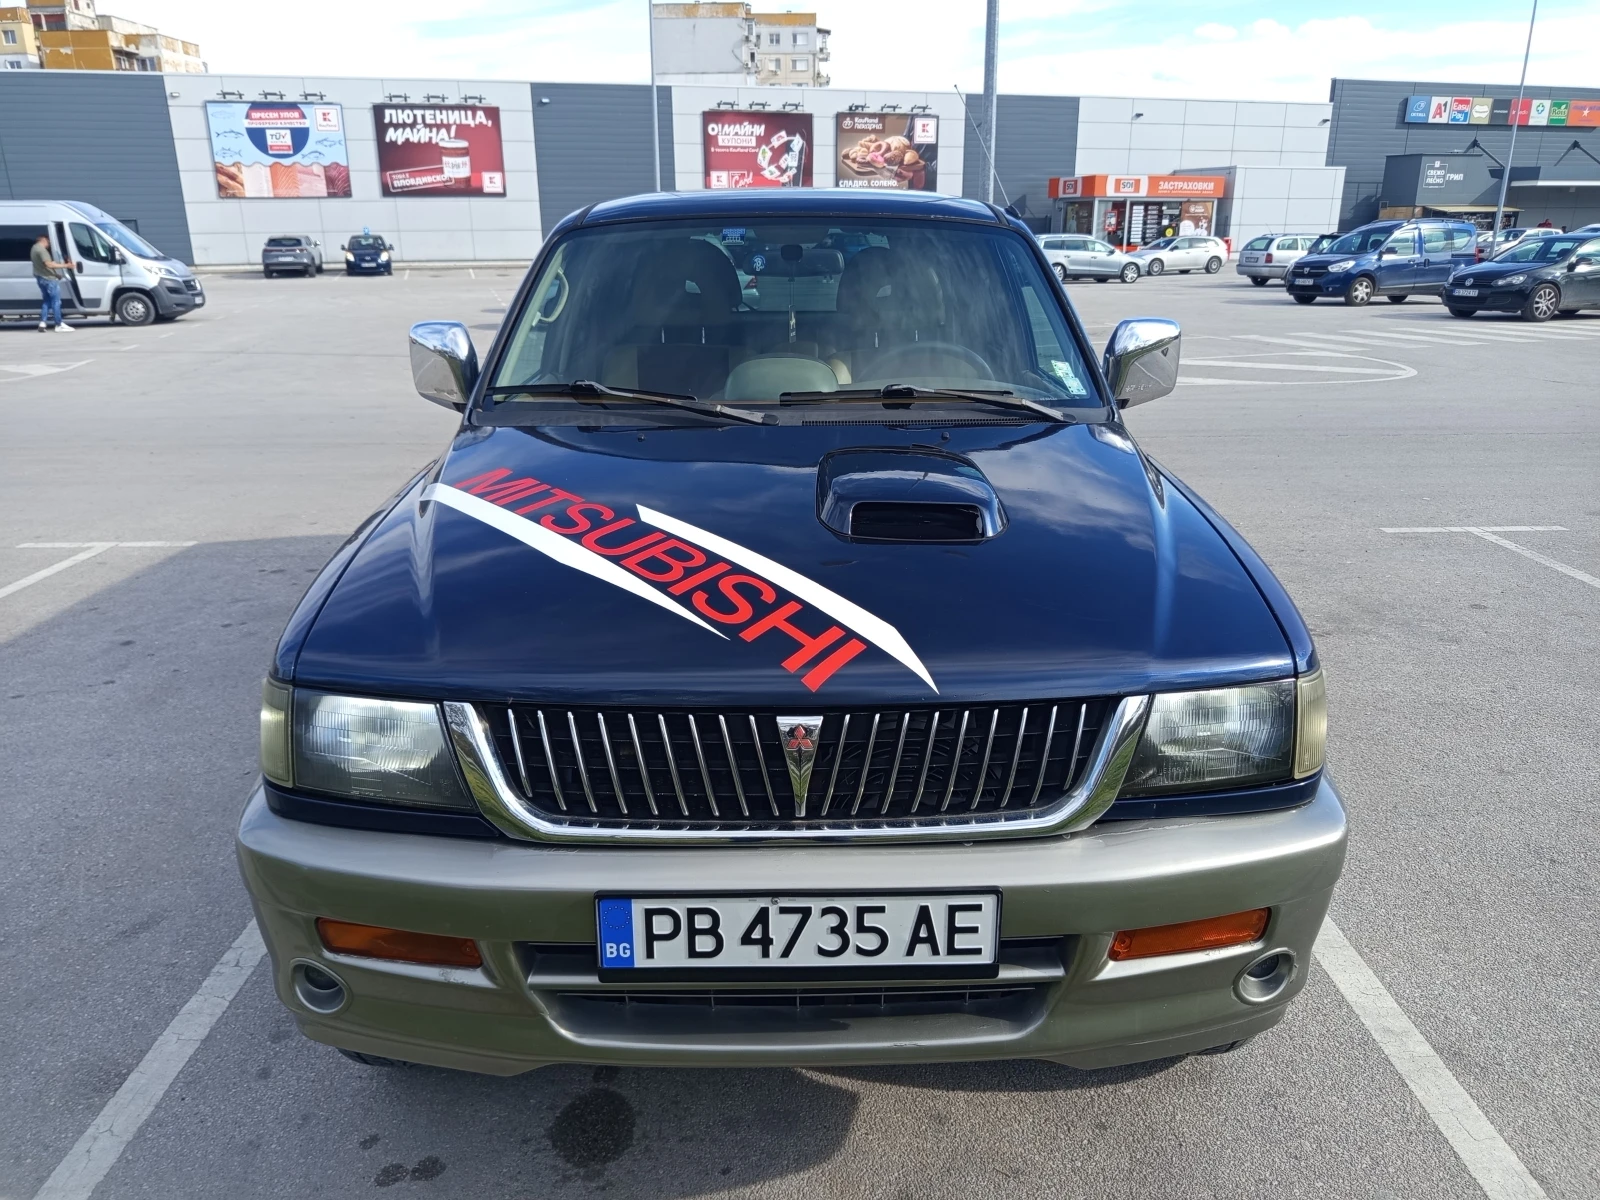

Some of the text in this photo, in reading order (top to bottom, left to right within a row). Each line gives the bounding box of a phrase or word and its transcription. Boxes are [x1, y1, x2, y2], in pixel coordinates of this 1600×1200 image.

[251, 111, 279, 119] ПРЕСЕН
[1432, 101, 1448, 119] A1
[1453, 102, 1470, 112] Easy
[383, 109, 492, 127] ЛЮТЕНИЦА,
[1451, 111, 1465, 121] Pay
[385, 124, 457, 145] МАЙНА!
[1446, 173, 1464, 181] ГРИЛ
[1158, 181, 1214, 190] ЗАСТРАХОВКИ
[456, 468, 867, 693] MITSUBISHI
[644, 903, 984, 959] PB 4735 AE
[606, 942, 631, 958] BG
